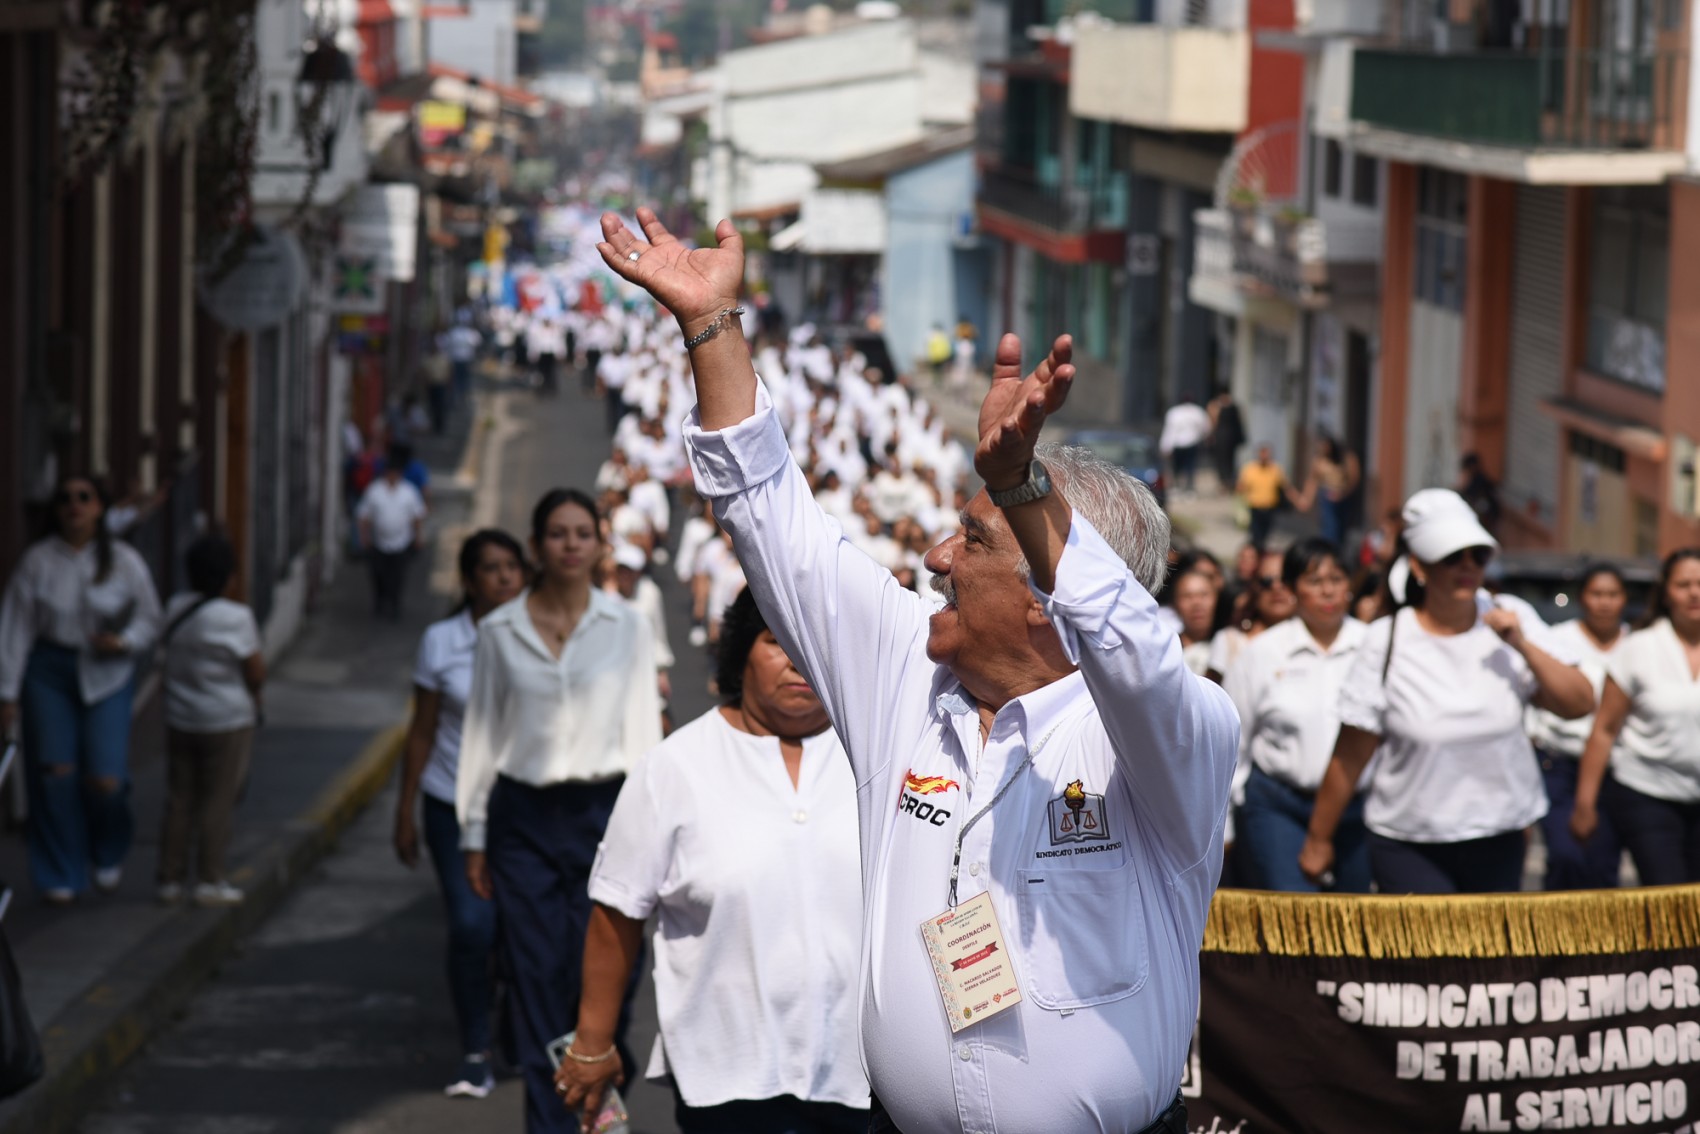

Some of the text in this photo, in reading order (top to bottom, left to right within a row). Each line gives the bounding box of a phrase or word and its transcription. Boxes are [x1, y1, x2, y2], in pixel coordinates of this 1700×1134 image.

[900, 793, 951, 827] CROC
[1035, 841, 1122, 859] SINDICATO DEMOCRÁTICO
[947, 923, 991, 948] COORDINACIÓN
[982, 964, 1002, 976] SALVADOR
[964, 982, 979, 992] SIERRA
[1316, 964, 1700, 1028] "SINDICATO DEMOCR
[1396, 1020, 1700, 1082] DE TRABAJADOR
[1460, 1078, 1688, 1132] AL SERVICIO
